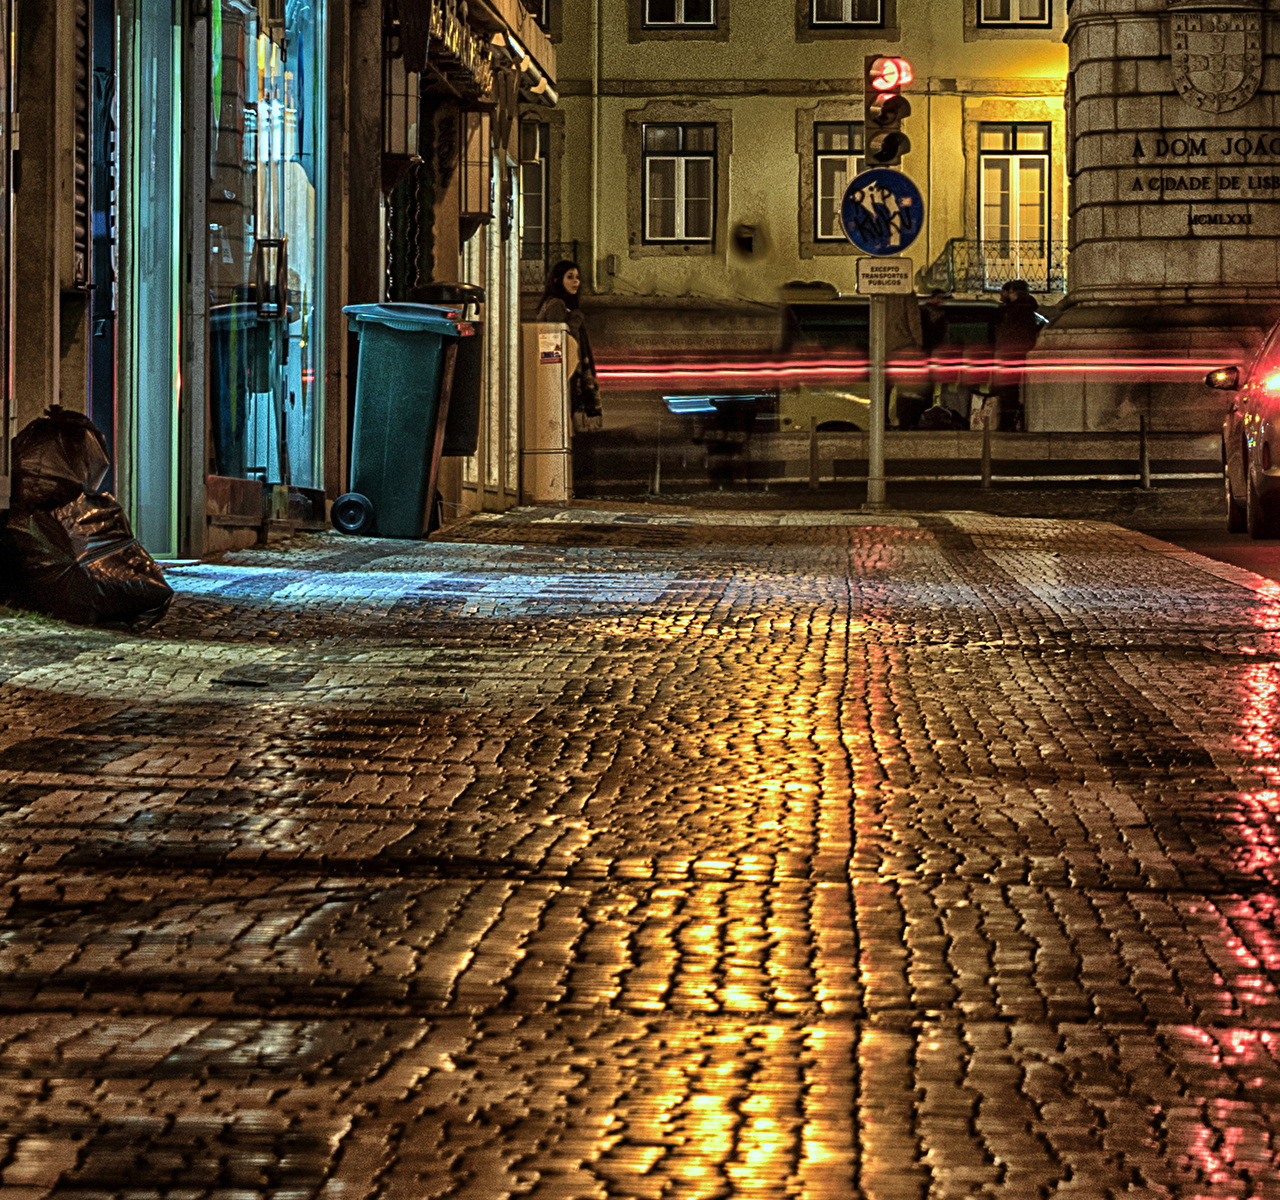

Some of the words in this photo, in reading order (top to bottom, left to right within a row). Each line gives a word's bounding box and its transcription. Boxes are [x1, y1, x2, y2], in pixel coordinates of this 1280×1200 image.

[1132, 138, 1145, 158] A
[1156, 138, 1207, 157] DOM
[1132, 177, 1144, 191] A
[1149, 177, 1211, 191] CIDADE
[1219, 176, 1240, 190] DE
